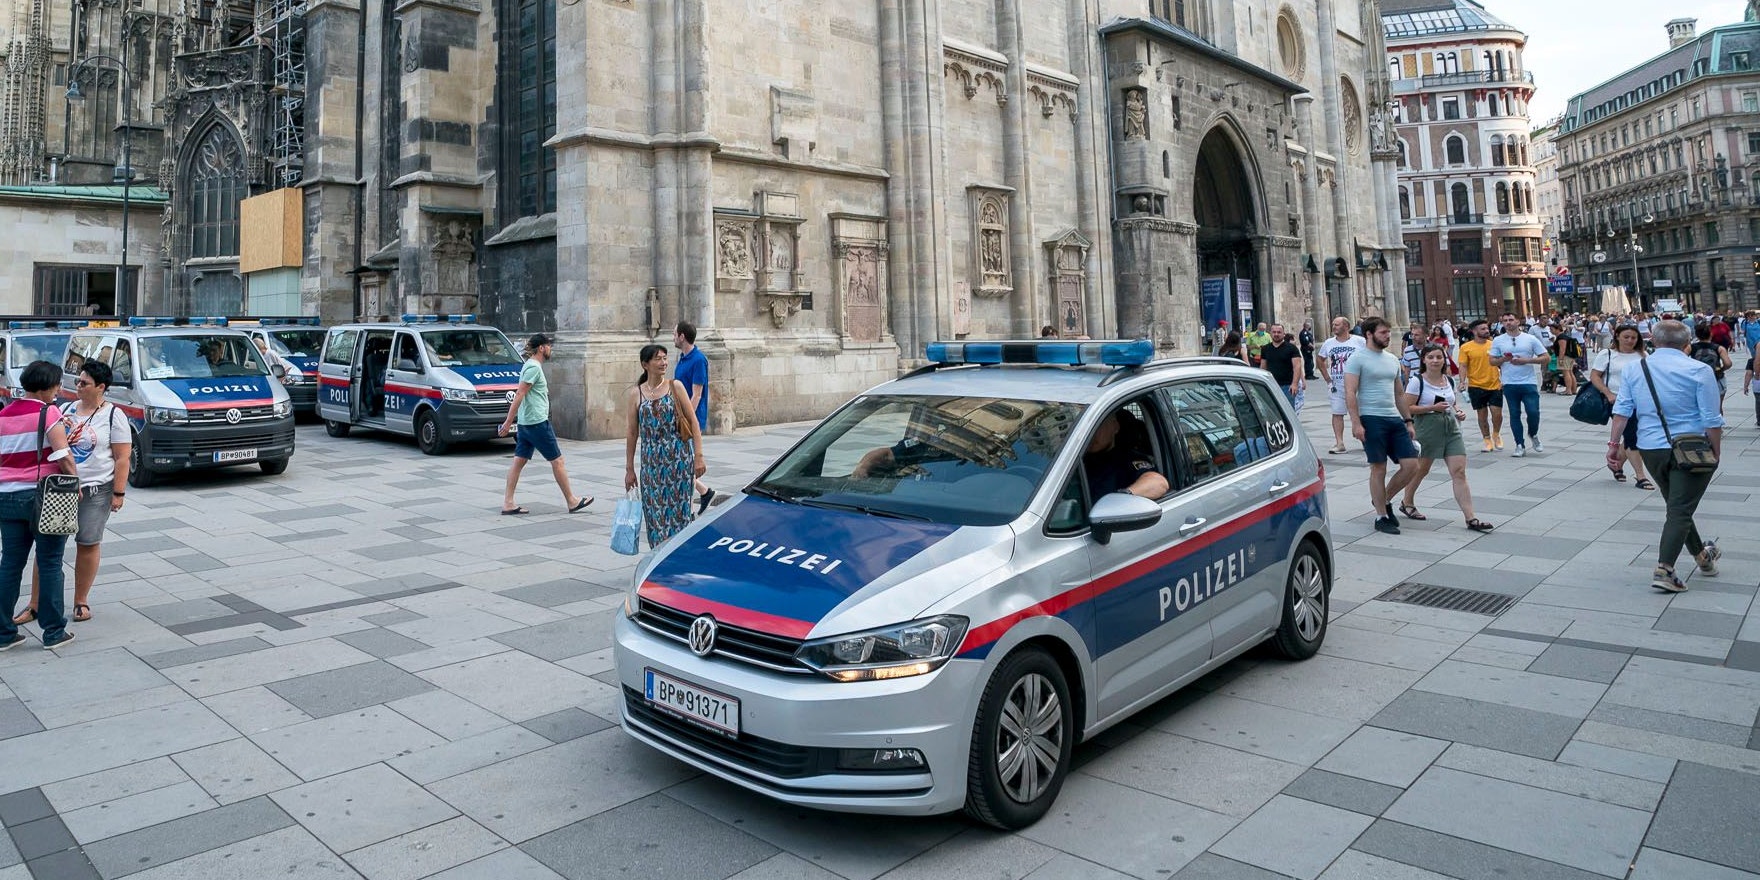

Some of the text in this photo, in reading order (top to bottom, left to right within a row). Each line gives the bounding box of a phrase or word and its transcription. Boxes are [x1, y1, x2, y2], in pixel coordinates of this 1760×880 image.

[474, 371, 521, 379] POLIZE
[189, 385, 259, 395] POLIZEI
[707, 536, 843, 575] POLIZEI
[1158, 548, 1245, 622] POLIZEI
